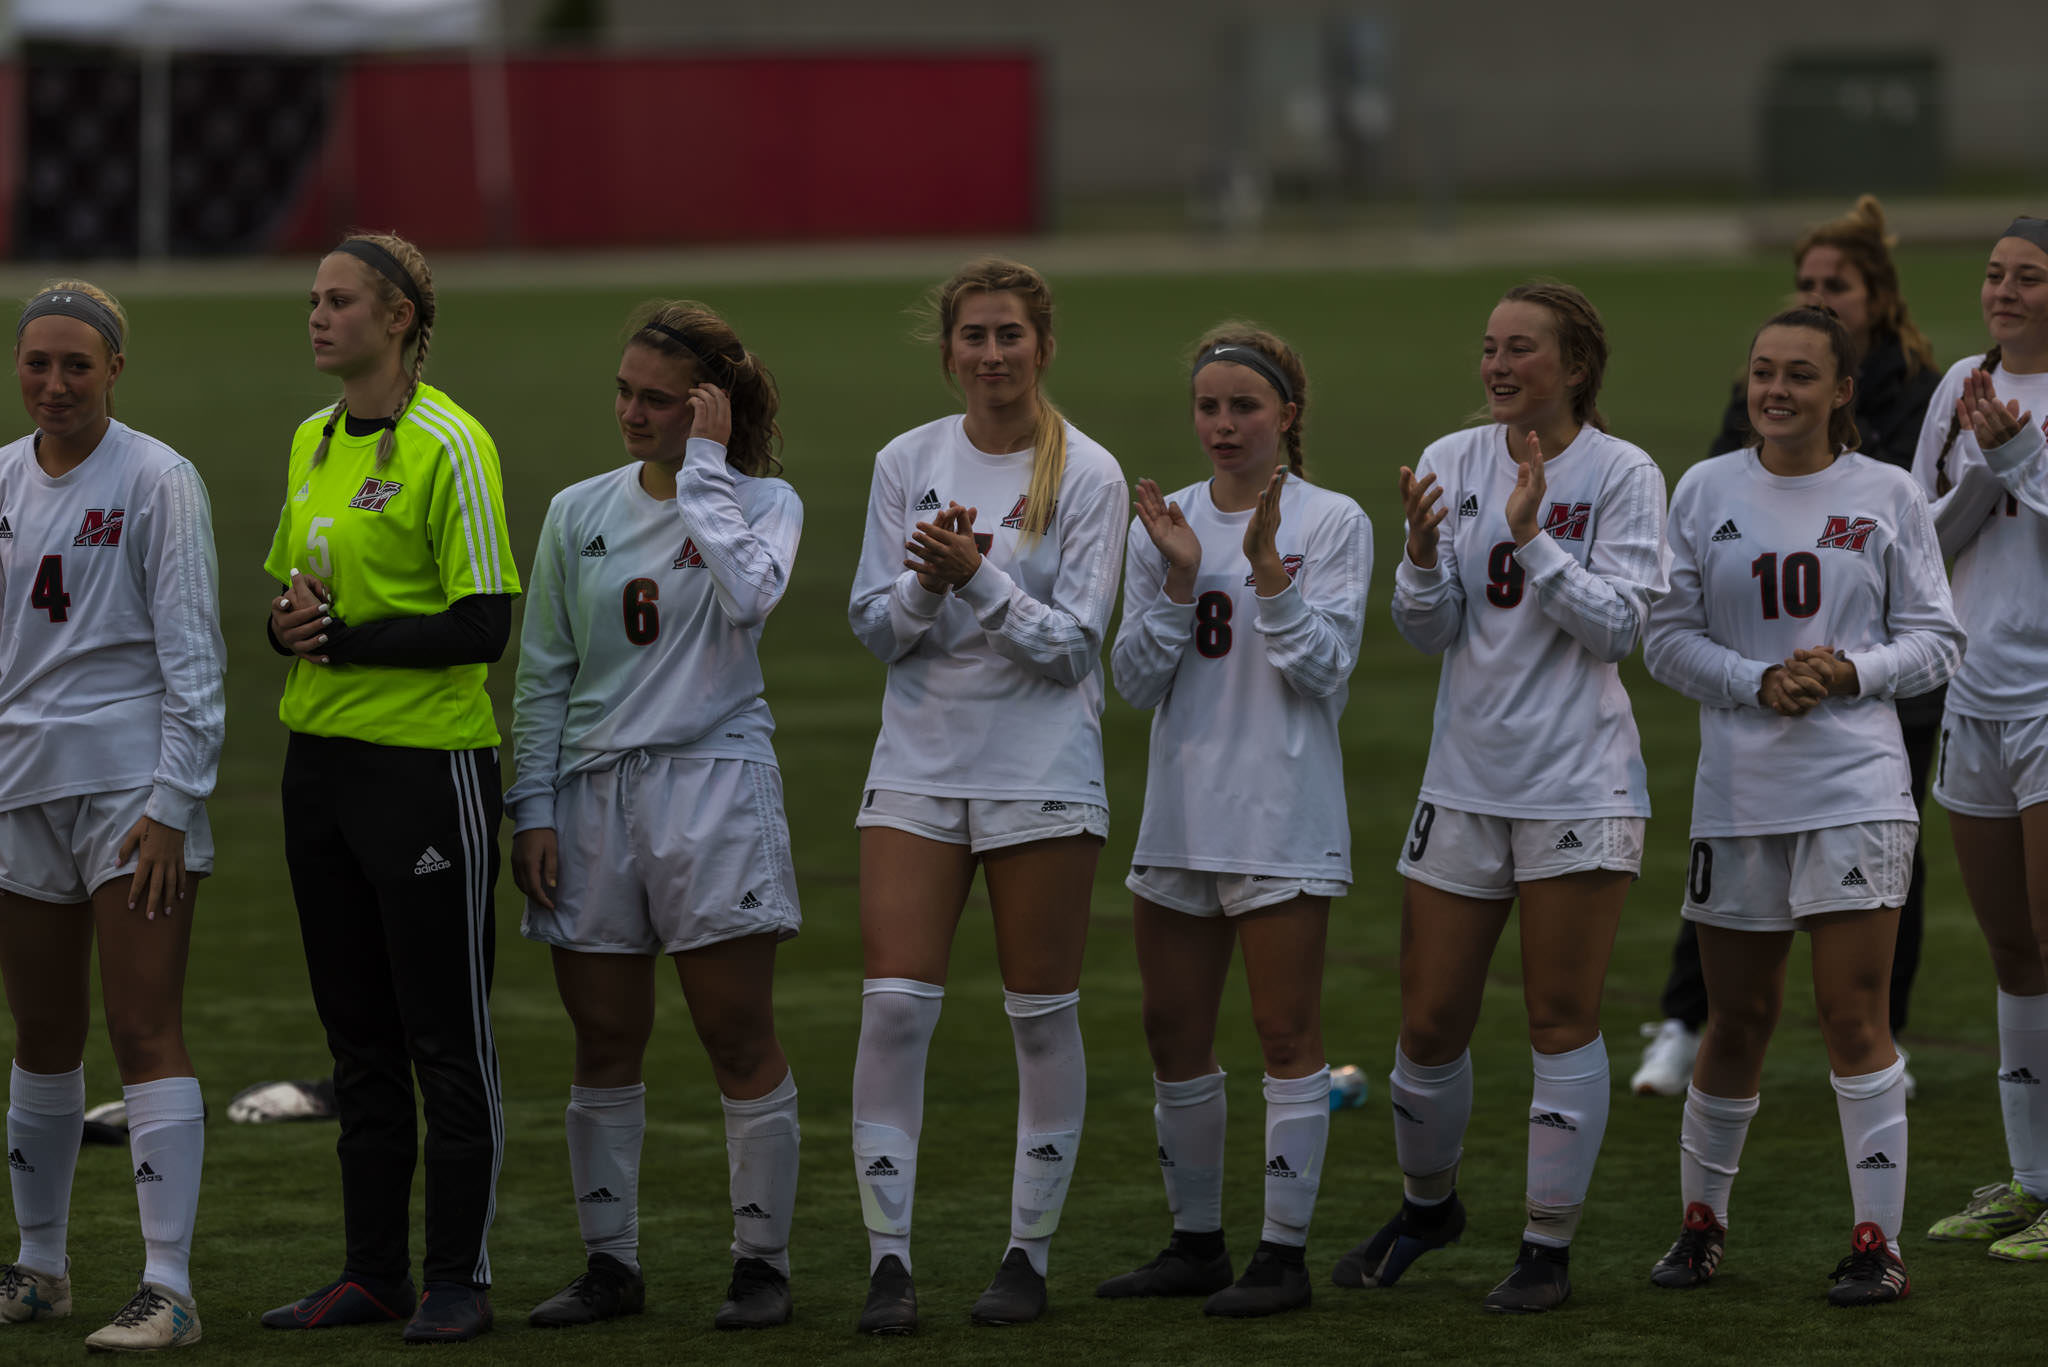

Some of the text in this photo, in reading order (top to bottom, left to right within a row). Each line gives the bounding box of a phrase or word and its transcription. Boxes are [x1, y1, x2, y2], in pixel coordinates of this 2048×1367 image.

[915, 503, 941, 511] adidas
[306, 517, 335, 578] 5
[1711, 533, 1742, 542] adidas
[31, 554, 71, 623] 4
[1486, 541, 1525, 609] 9
[1752, 552, 1821, 620] 10
[623, 577, 660, 646] 6
[1196, 590, 1233, 659] 8
[1408, 802, 1435, 862] 9
[1555, 841, 1582, 849] adidas
[414, 862, 451, 876] adidas
[1841, 878, 1868, 886] adidas
[865, 1168, 900, 1176] adidas
[1026, 1151, 1063, 1162] adidas
